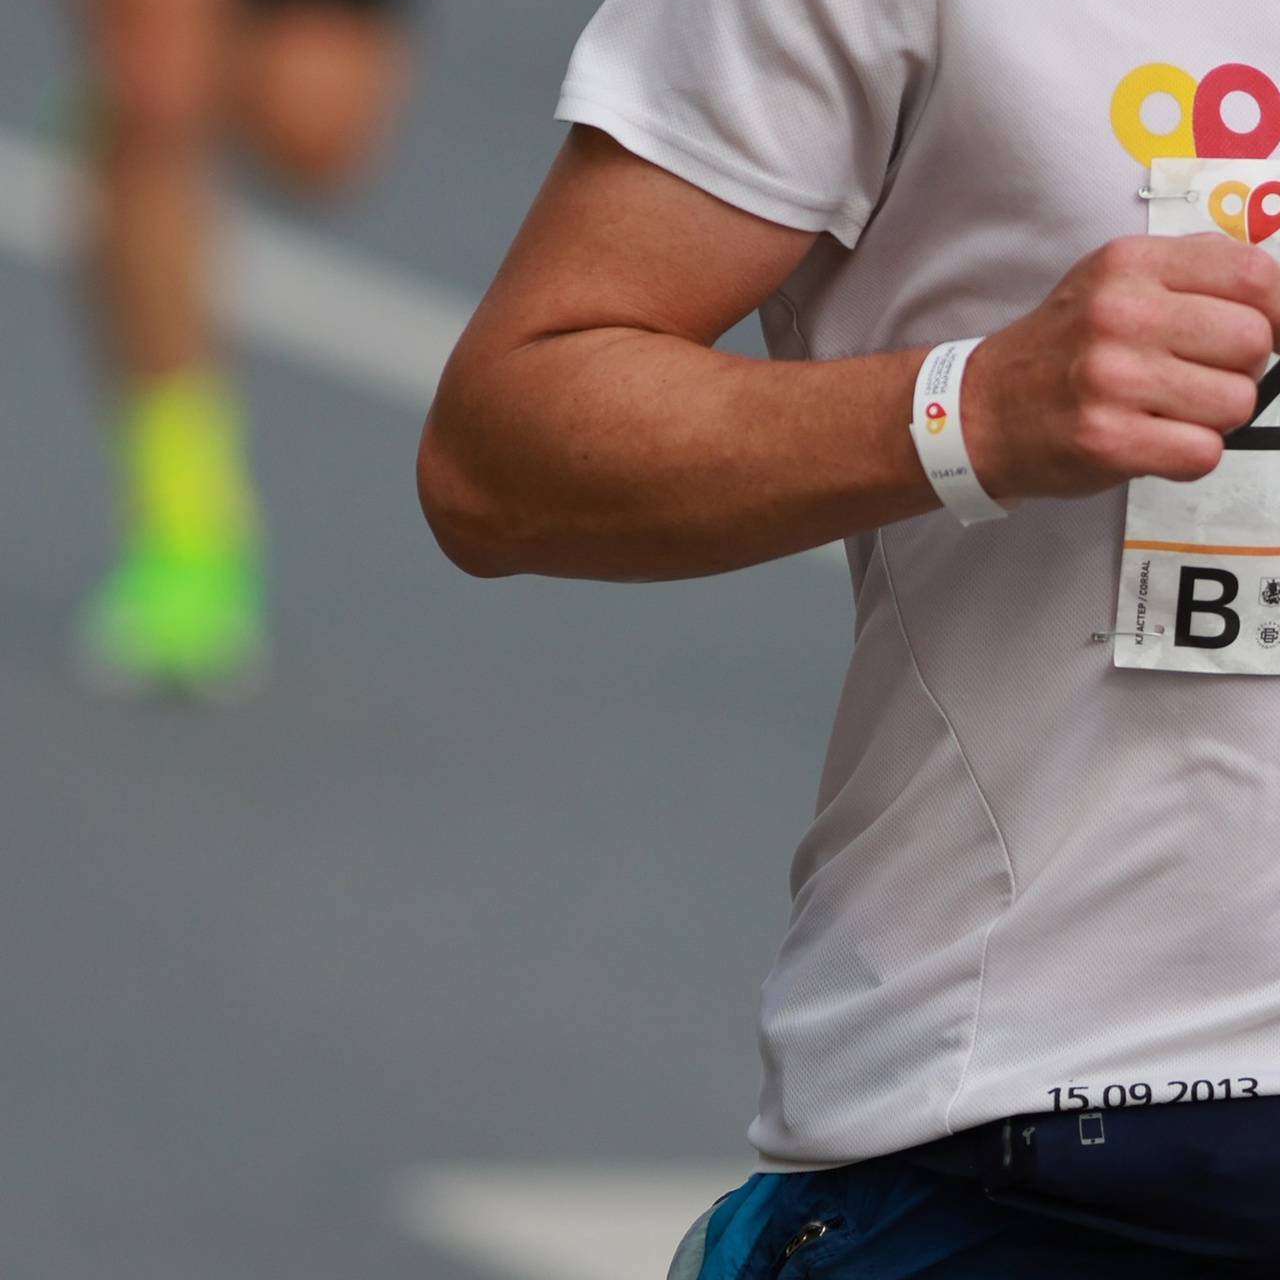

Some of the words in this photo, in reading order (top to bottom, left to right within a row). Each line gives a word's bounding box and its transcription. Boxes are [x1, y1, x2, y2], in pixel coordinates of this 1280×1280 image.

[1139, 560, 1151, 596] CORRAL
[1174, 565, 1240, 650] B
[1047, 1077, 1260, 1111] 15.092013
